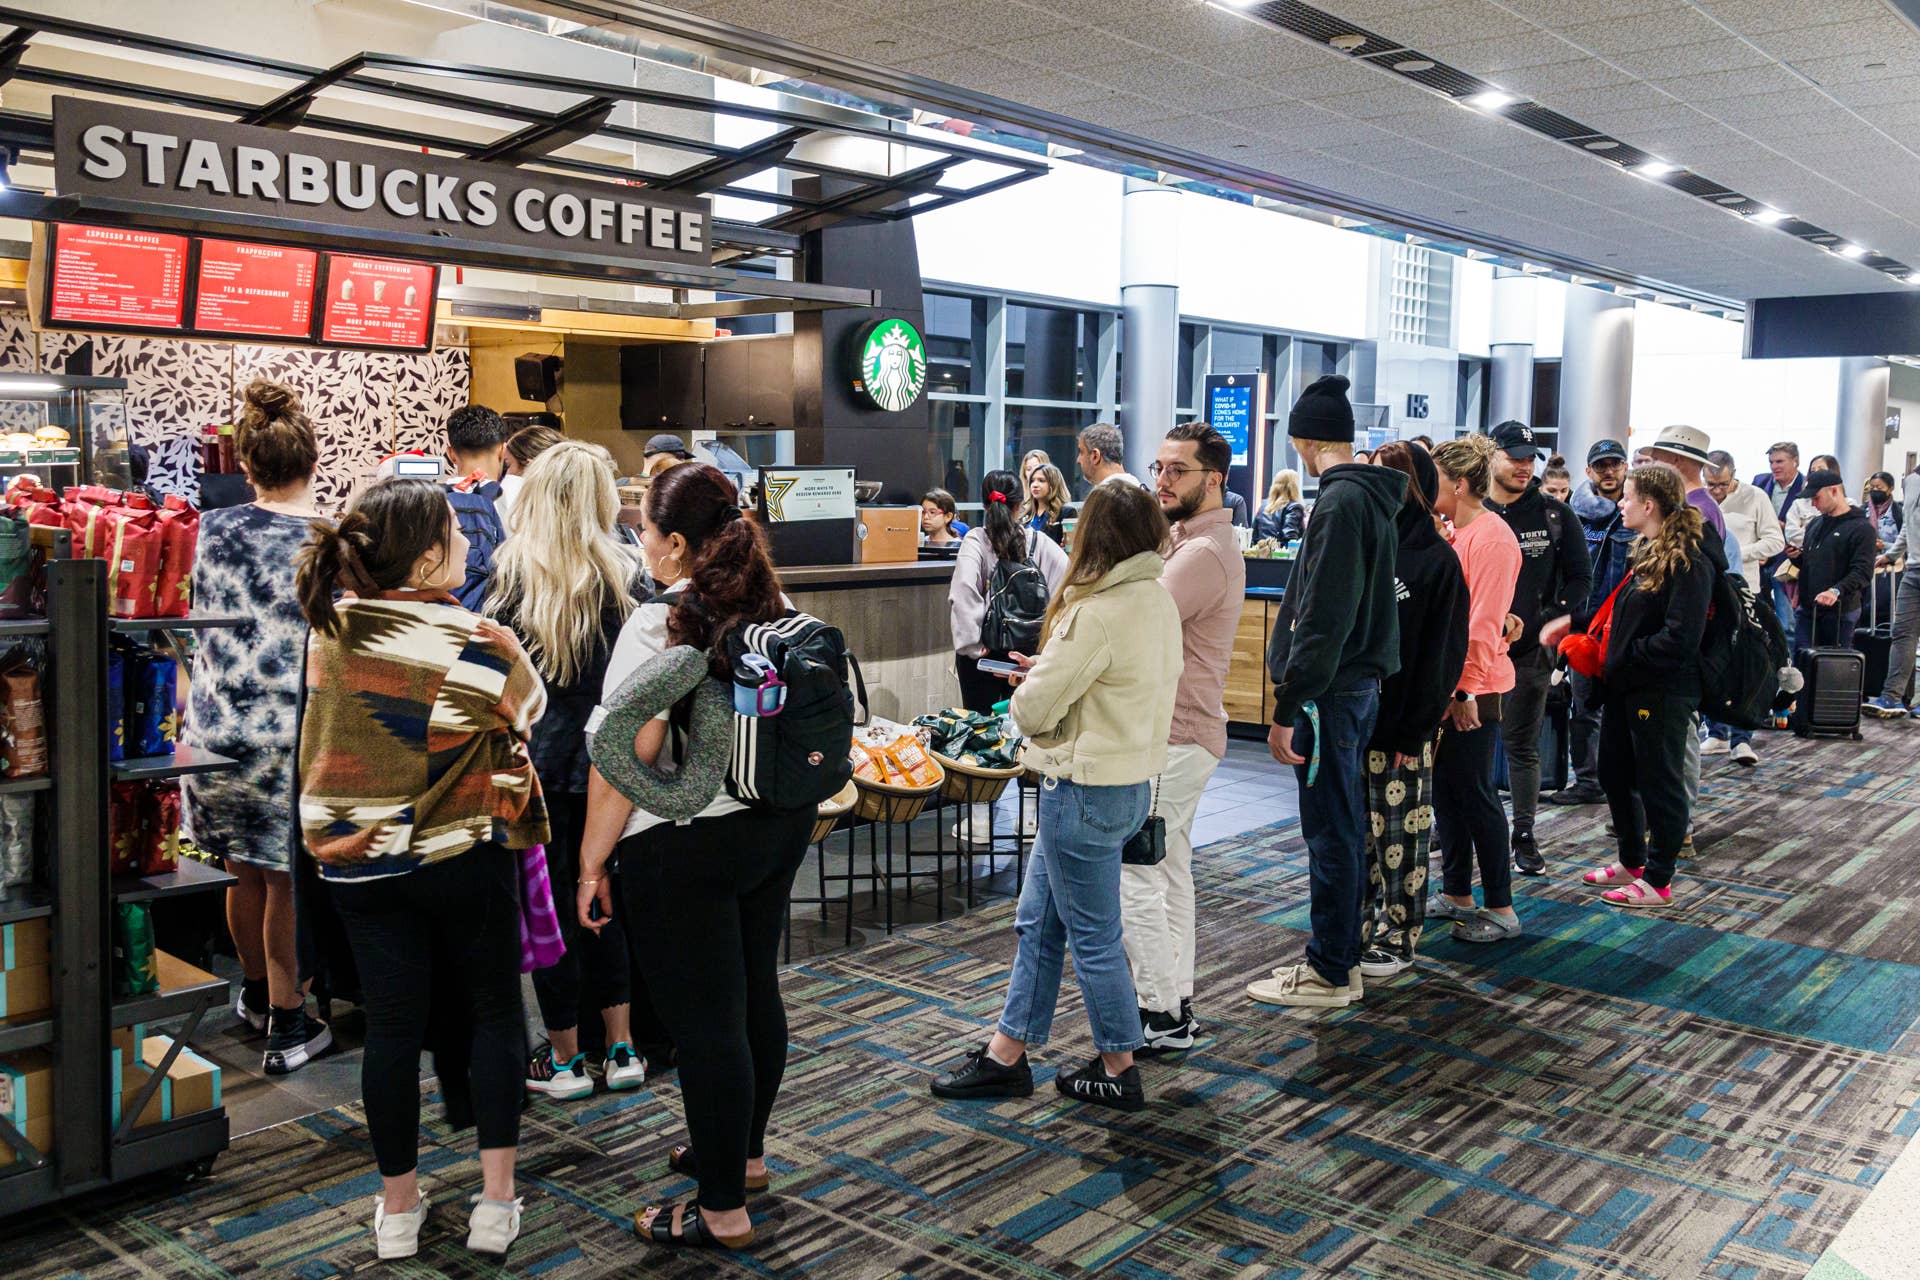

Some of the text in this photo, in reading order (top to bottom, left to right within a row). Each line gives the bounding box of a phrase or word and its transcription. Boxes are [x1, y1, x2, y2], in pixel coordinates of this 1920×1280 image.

[82, 124, 704, 253] STARBUCKS COFFEE
[86, 230, 123, 241] ESPRESSO
[134, 235, 159, 244] COFFEE
[223, 286, 235, 294] TEA
[1405, 393, 1430, 420] H5
[1520, 529, 1548, 539] TOKYO
